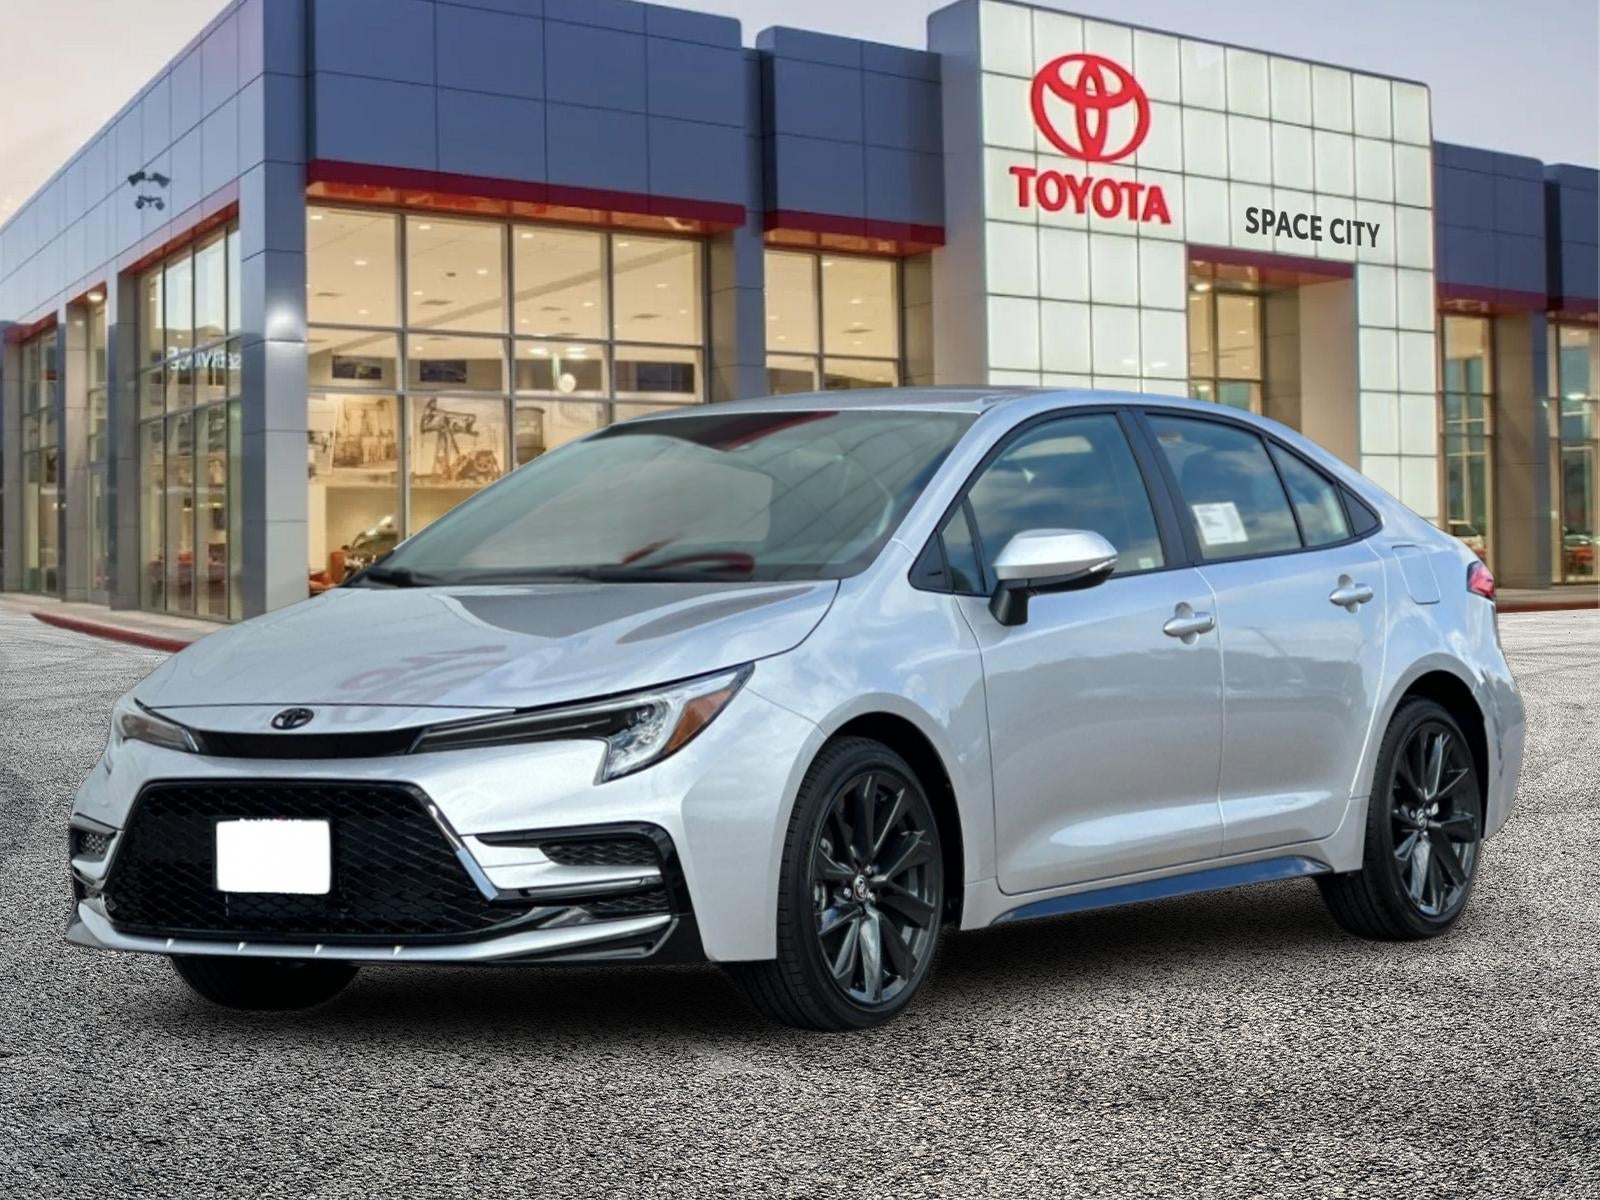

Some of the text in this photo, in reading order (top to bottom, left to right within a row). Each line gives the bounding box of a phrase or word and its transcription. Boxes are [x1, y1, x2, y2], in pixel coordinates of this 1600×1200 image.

[1009, 167, 1171, 224] TOYOTA
[1245, 206, 1381, 248] SPACE CITY
